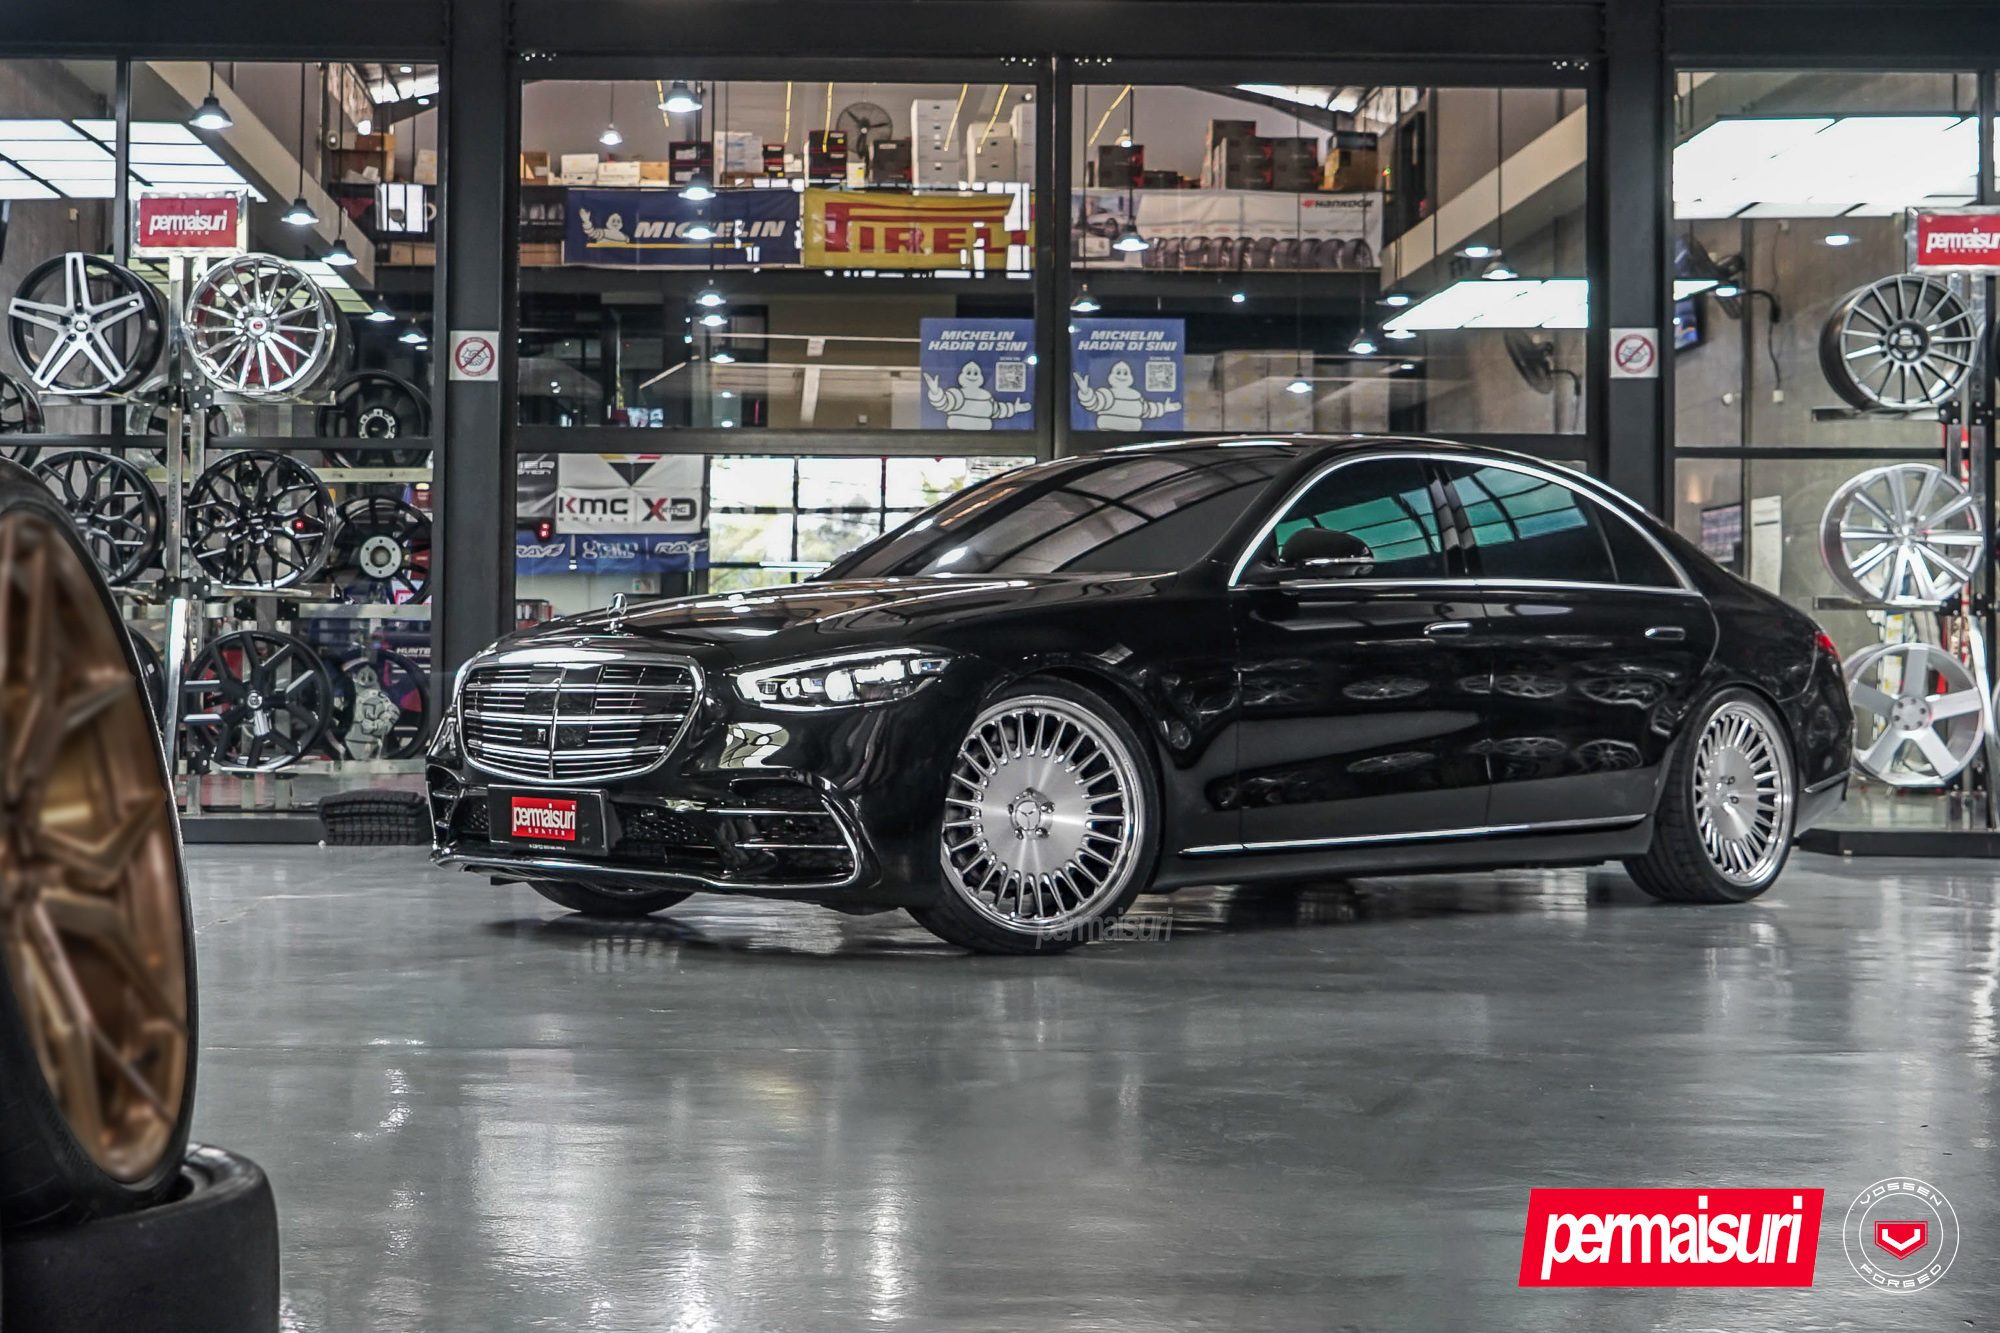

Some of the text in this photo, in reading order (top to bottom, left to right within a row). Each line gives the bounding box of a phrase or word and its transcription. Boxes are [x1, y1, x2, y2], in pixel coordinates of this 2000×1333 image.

[149, 210, 228, 235] permaisuri
[634, 220, 786, 239] MICELIN
[1925, 227, 2000, 253] permaisur
[940, 330, 1015, 341] MICHELIN
[1090, 330, 1165, 341] MICHELIN
[927, 341, 1028, 352] HADIR DI SINI
[1078, 341, 1178, 352] HADIR DI SINI
[513, 803, 576, 831] permaisuri
